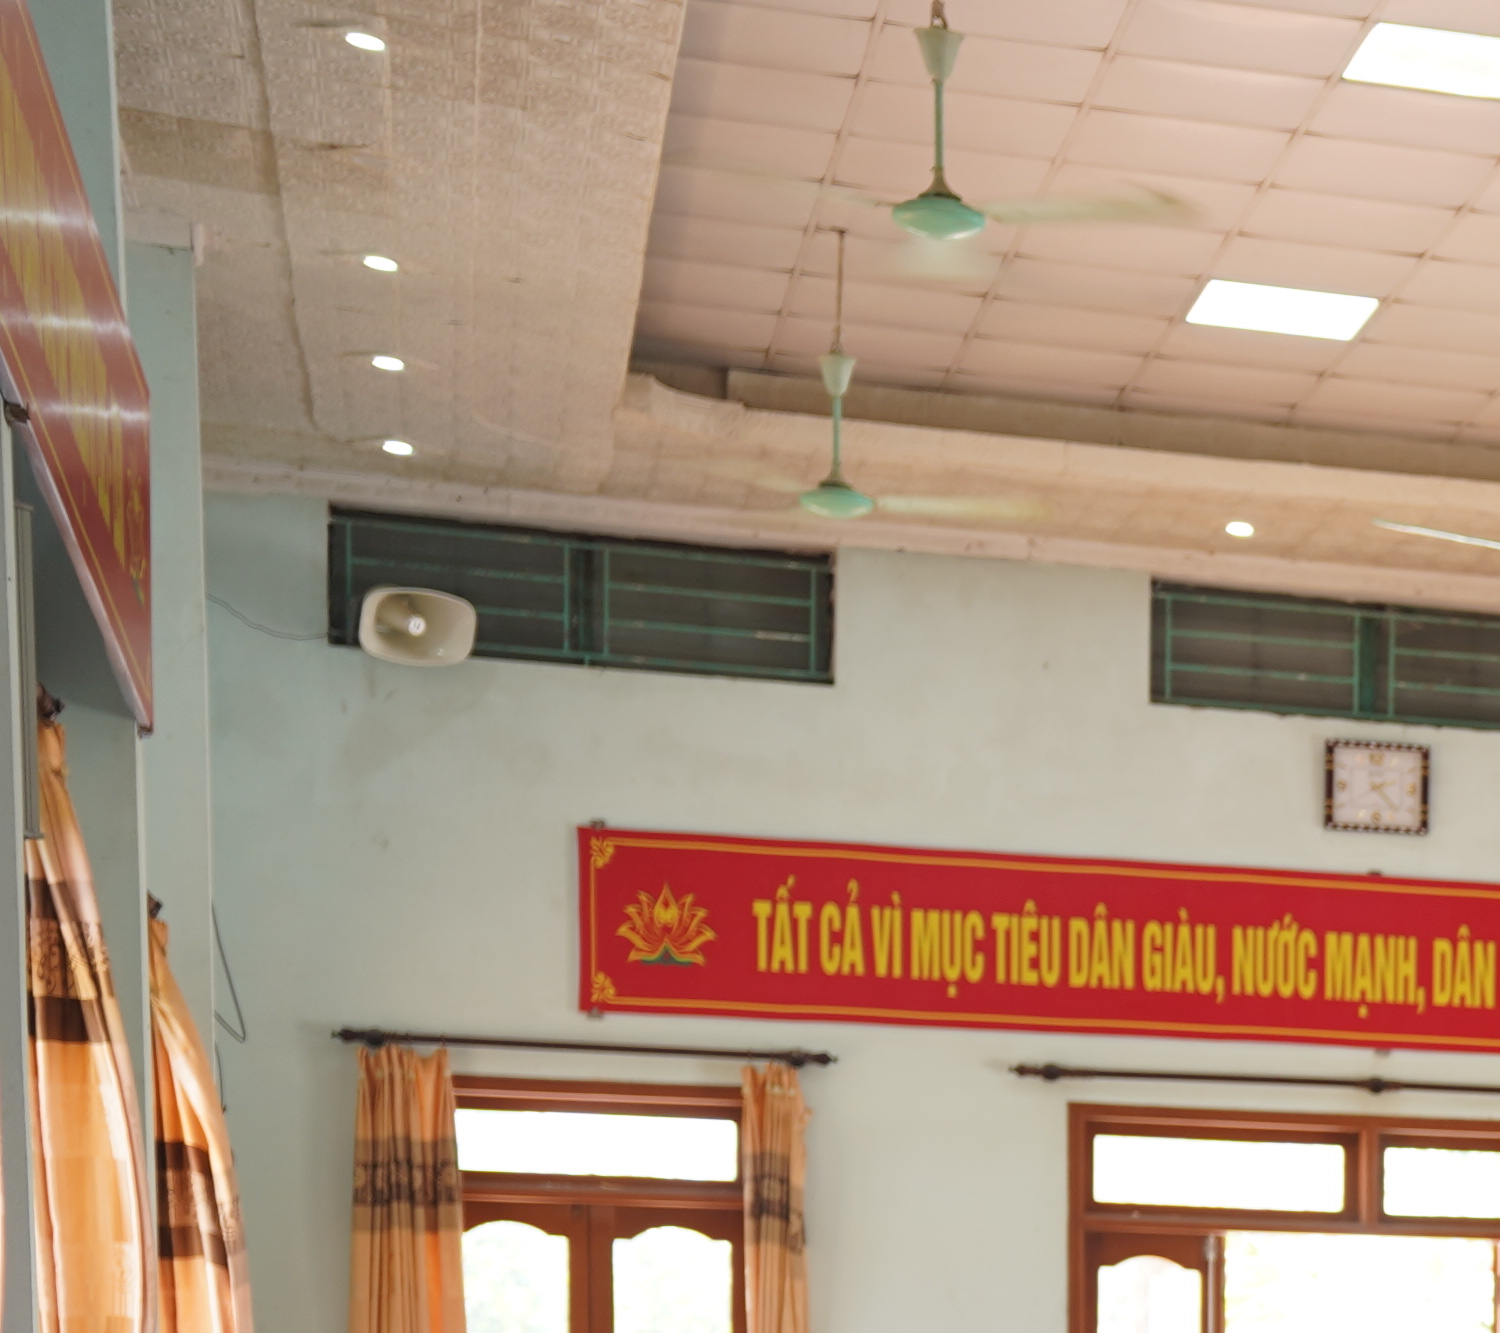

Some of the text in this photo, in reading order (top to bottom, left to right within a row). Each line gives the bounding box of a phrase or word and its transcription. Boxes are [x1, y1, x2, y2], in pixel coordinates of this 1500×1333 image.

[752, 875, 812, 974] TẤT
[820, 878, 864, 976] CẢ
[871, 891, 901, 979] VÌ
[910, 909, 985, 998] MỤC
[992, 898, 1060, 987] TIÊU
[1069, 901, 1135, 990] DÂN
[1142, 906, 1225, 1003] GIÀU,
[1232, 912, 1317, 1000] NƯỚC
[1325, 931, 1426, 1018] MẠNH,
[1433, 924, 1496, 1009] DÂN
